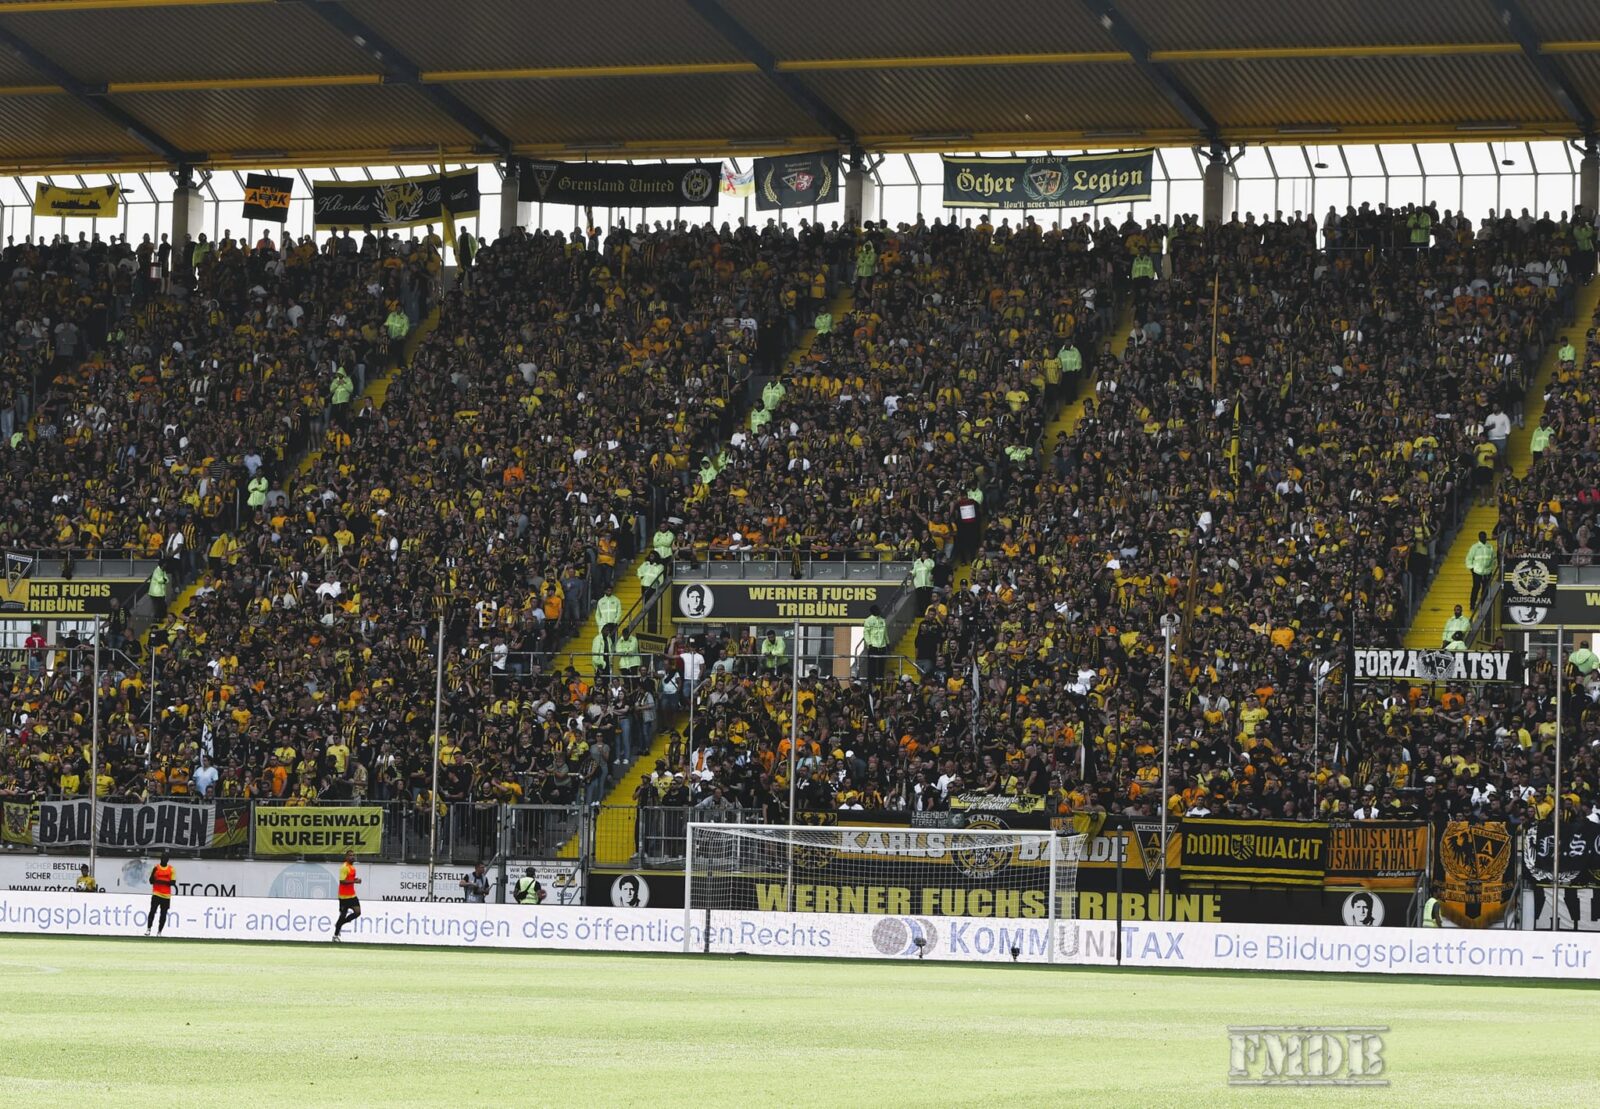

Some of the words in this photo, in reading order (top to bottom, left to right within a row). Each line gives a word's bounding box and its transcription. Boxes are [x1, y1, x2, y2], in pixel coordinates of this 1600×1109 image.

[558, 176, 625, 193] Grenzland
[629, 177, 675, 193] United
[956, 168, 1016, 197] Öcher
[1072, 169, 1143, 193] Legion
[1049, 199, 1067, 208] walk
[1068, 198, 1089, 207] alone
[62, 584, 111, 597] FUCHS
[749, 587, 818, 600] WERNER
[822, 587, 877, 600] FUCHS
[776, 602, 848, 616] TRIBÜNE
[1355, 650, 1418, 677] FORZA
[1453, 652, 1510, 681] ATSV
[257, 812, 381, 827] HÜRTGENWALD
[912, 811, 949, 819] LEGENDEN
[39, 803, 92, 843] BAD
[100, 804, 209, 847] AACHEN
[271, 831, 366, 846] RUREIFEL
[841, 830, 946, 858] KARLS
[25, 872, 51, 880] SICHER
[431, 872, 465, 881] ESTELLT
[400, 881, 428, 890] SICHER
[755, 883, 911, 914] WERNER
[922, 888, 1046, 918] FUCHS
[1055, 889, 1222, 922] TRIBÜNE
[0, 903, 180, 930] dungsplattfom
[204, 906, 237, 928] für
[246, 909, 332, 933] andere
[522, 916, 569, 940] des
[740, 920, 831, 947] Rechts
[1214, 933, 1259, 960] Die
[1266, 936, 1525, 969] Bildungsplattform
[1552, 943, 1592, 969] für
